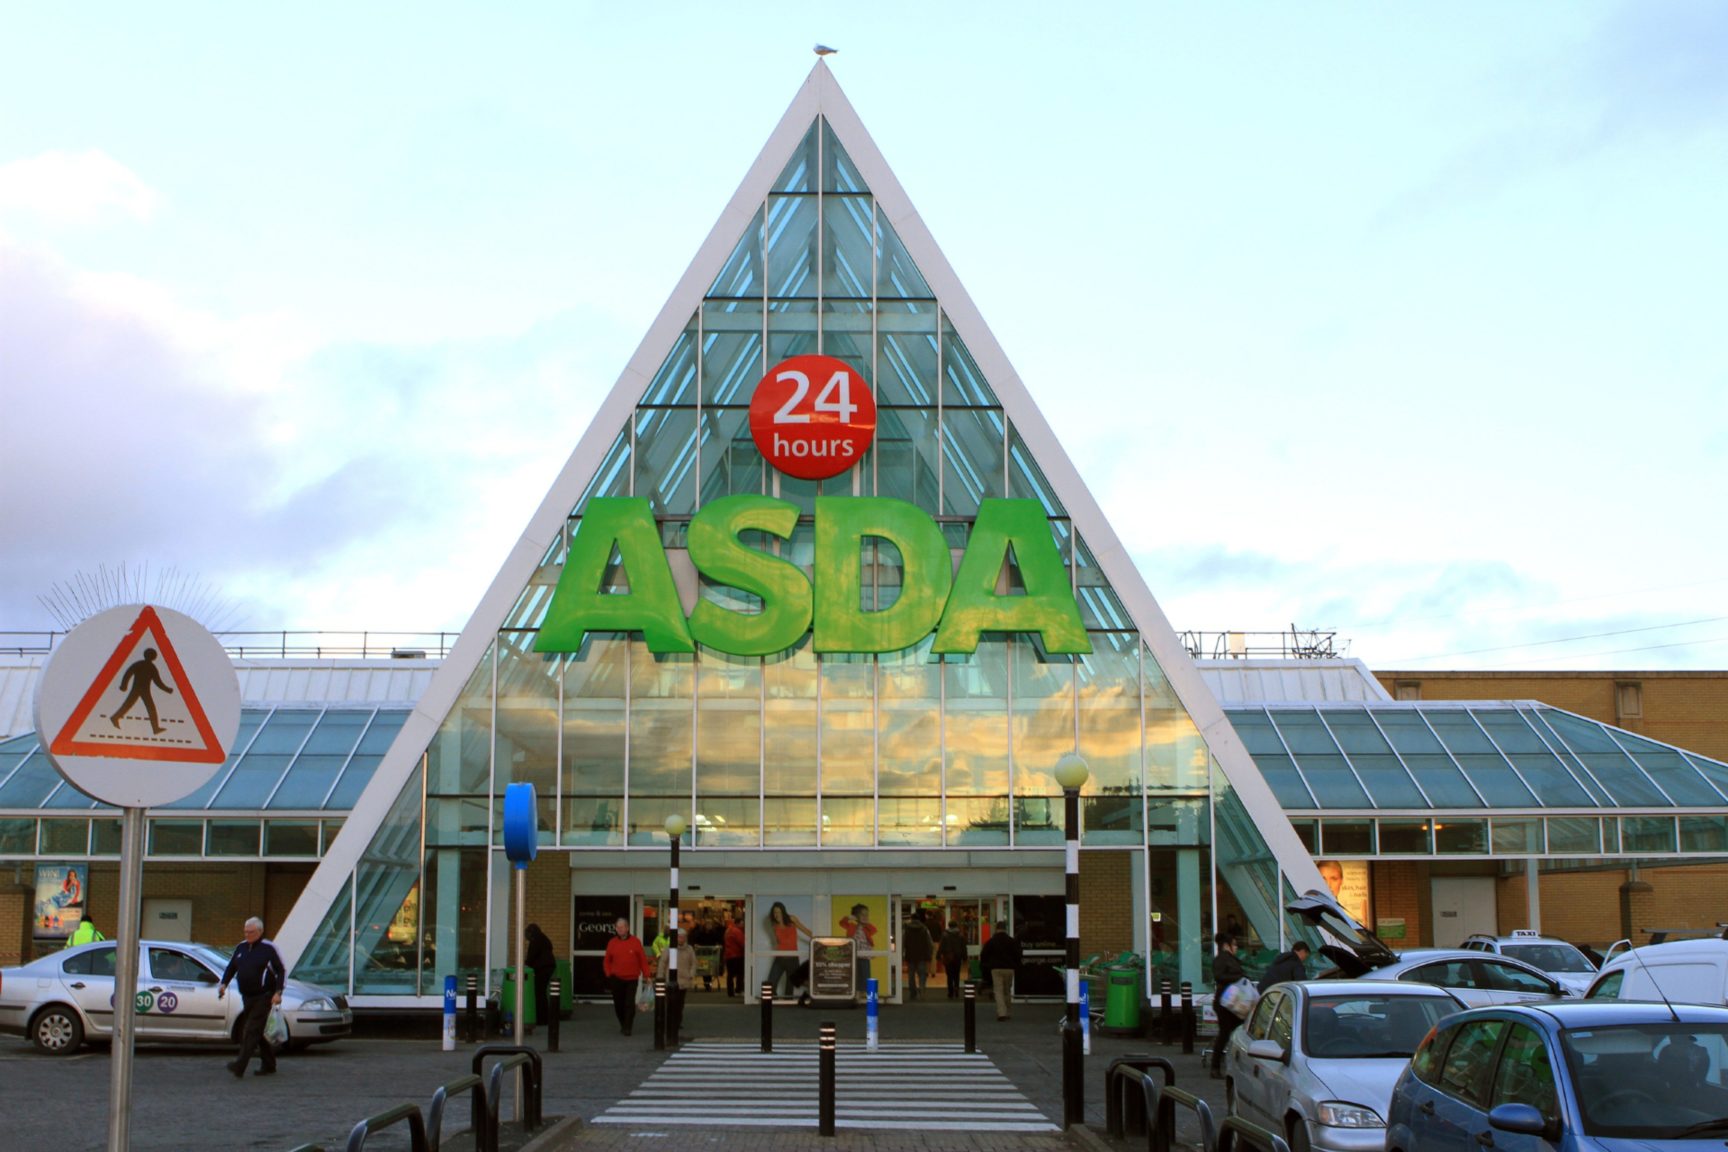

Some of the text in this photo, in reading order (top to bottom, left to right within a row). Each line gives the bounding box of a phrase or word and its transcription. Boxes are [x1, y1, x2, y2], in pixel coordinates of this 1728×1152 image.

[772, 370, 858, 424] 24
[773, 433, 854, 458] hours
[533, 494, 1093, 656] ASDA
[578, 921, 617, 936] Georg
[136, 995, 152, 1007] 30
[160, 996, 176, 1008] 20
